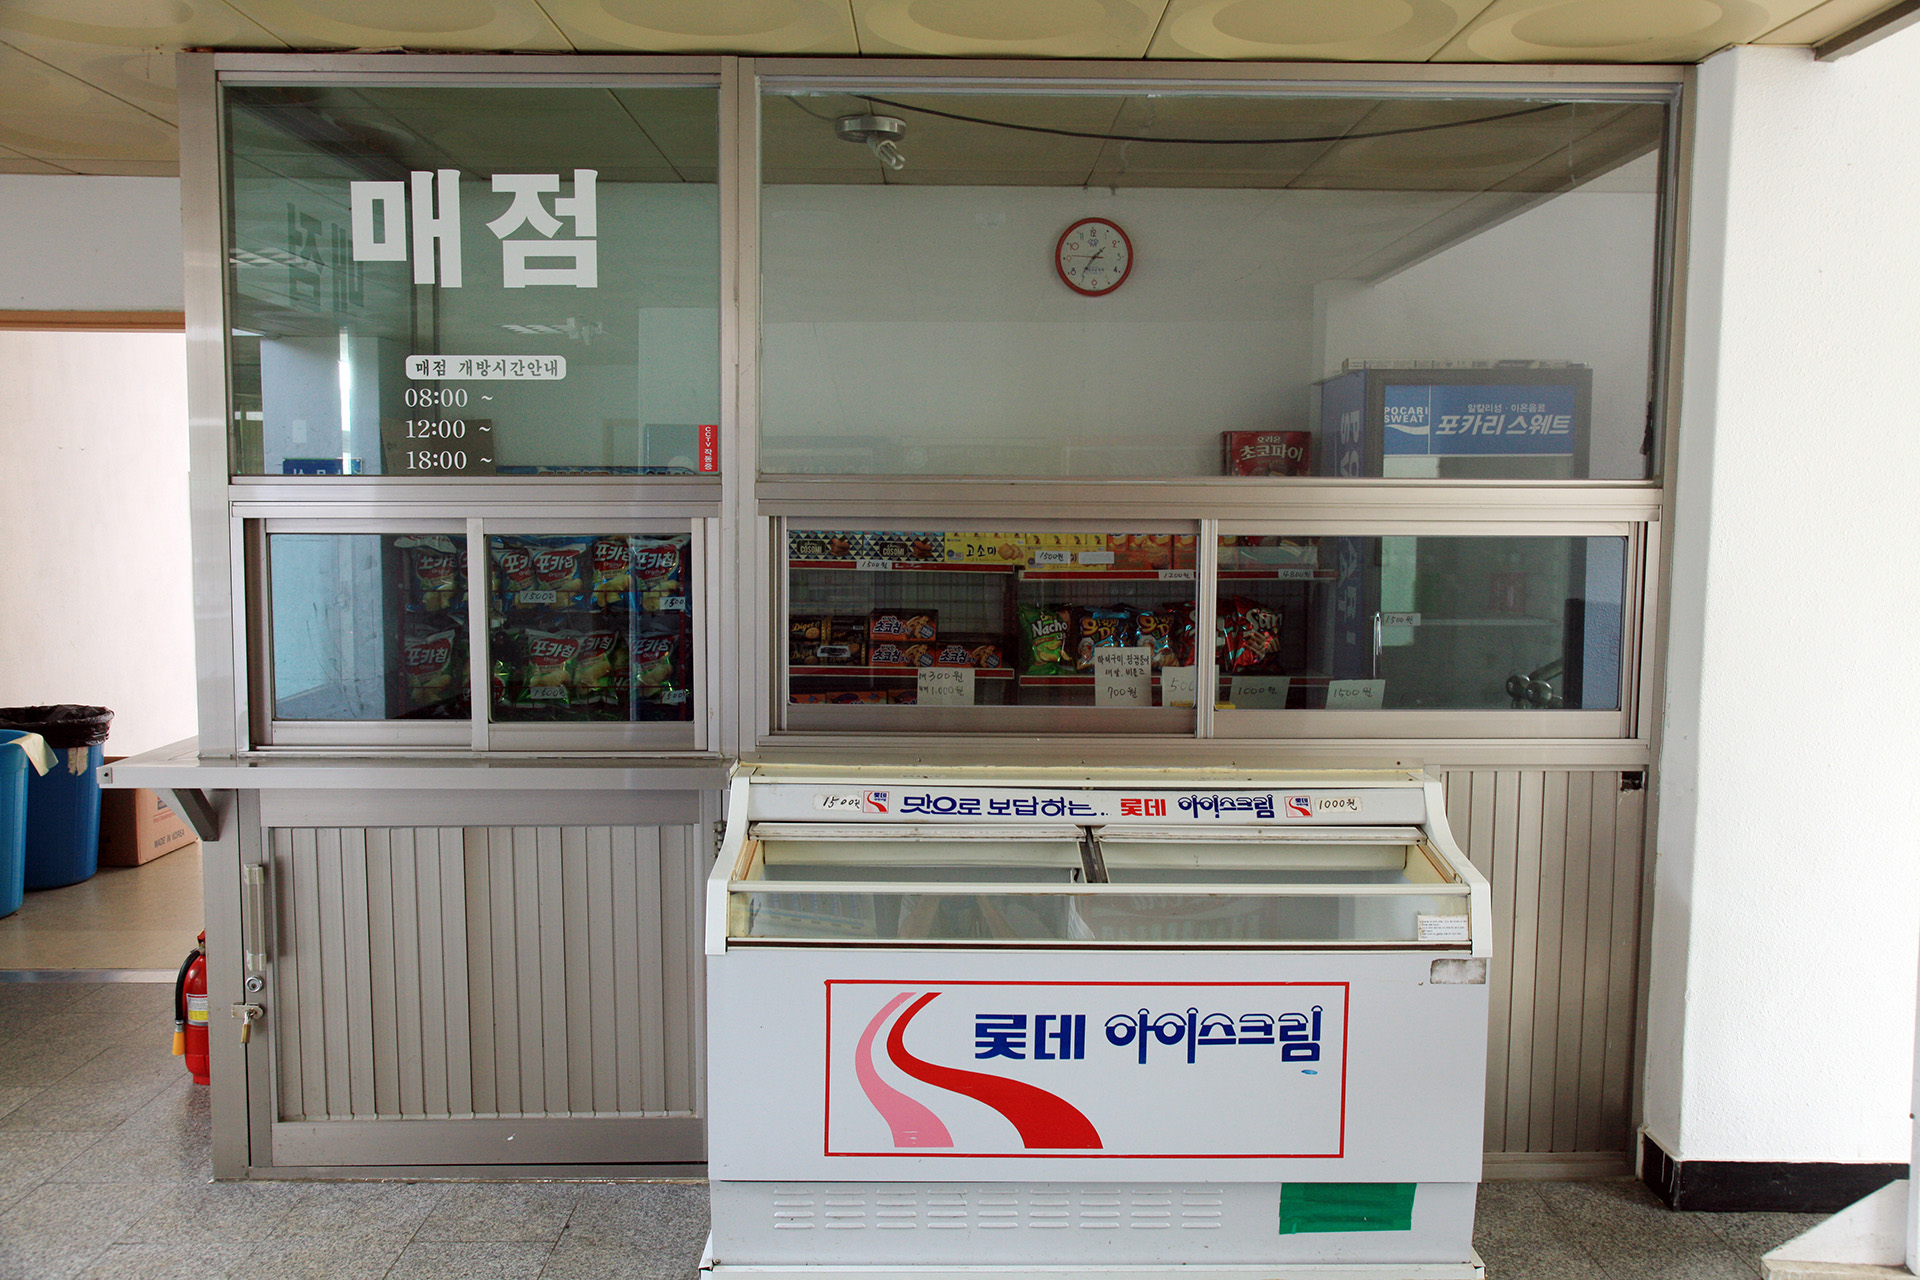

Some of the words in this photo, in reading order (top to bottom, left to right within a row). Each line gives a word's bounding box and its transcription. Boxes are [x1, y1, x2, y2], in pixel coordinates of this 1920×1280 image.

[350, 169, 598, 288] 매점
[1070, 268, 1076, 276] 8
[415, 359, 447, 377] 매점
[458, 359, 558, 377] 개방시간안내
[404, 388, 468, 408] 08:00
[1384, 406, 1429, 415] POCARI
[1384, 415, 1424, 423] SWEAT
[405, 419, 466, 439] 12:00
[1435, 415, 1507, 435] 포카리
[1505, 415, 1572, 435] 스웨트
[406, 450, 467, 470] 18:00
[1239, 443, 1304, 463] 초코파이
[966, 544, 997, 557] 고소미
[536, 554, 575, 573] 포카칩
[634, 551, 676, 570] 포카칩
[664, 599, 685, 608] 1500
[1031, 619, 1068, 638] Nacho
[531, 640, 576, 658] 포카칩
[632, 638, 672, 655] 포카칩
[407, 647, 448, 665] 포카칩
[1107, 686, 1138, 699] 700원
[899, 794, 983, 815] 맛으로
[1120, 798, 1167, 817] 롯데
[1177, 793, 1275, 818] 아이스크림
[1319, 799, 1358, 811] 1000원
[974, 1013, 1086, 1060] 롯데
[1104, 1005, 1323, 1064] 아이스크림
